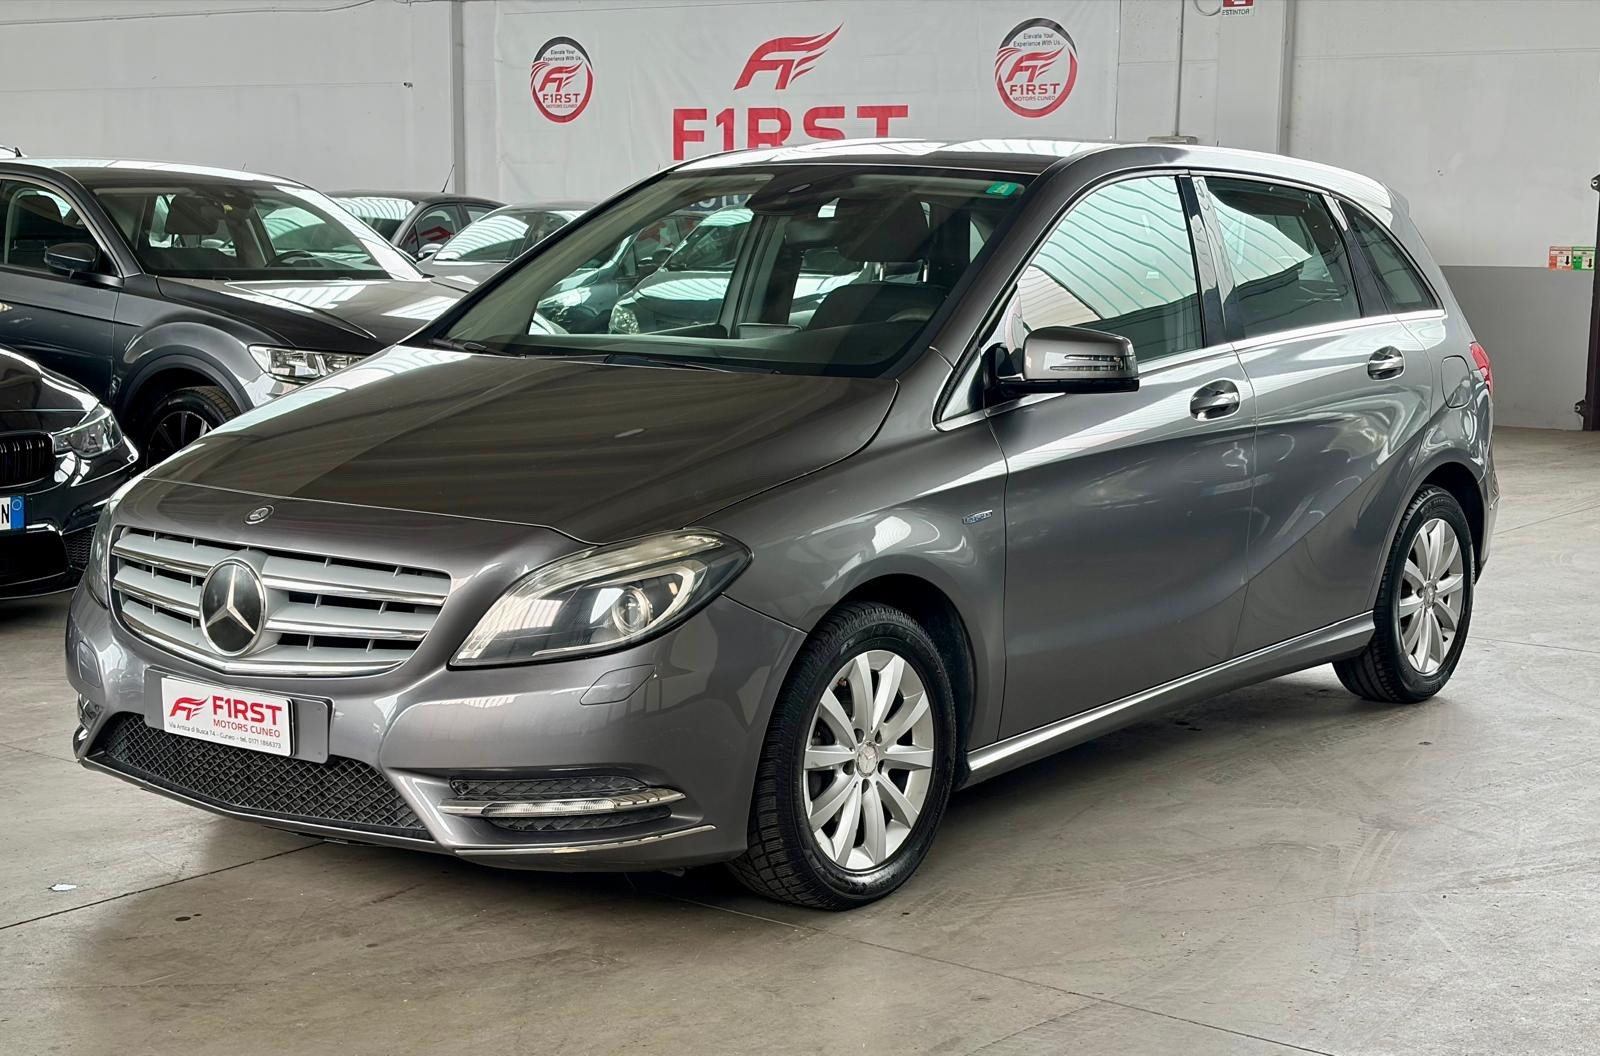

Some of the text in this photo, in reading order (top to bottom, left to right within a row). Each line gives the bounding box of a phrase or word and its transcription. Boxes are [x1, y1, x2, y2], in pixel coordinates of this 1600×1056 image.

[1013, 40, 1041, 48] Experience
[1023, 32, 1042, 40] Elevate
[1009, 83, 1061, 96] F1RST
[543, 93, 580, 103] F1RST
[673, 105, 909, 161] F1RST
[212, 695, 283, 726] F1RST
[168, 721, 176, 729] Via
[219, 732, 236, 741] Cuneo
[213, 718, 281, 738] MOTORS CUNEO
